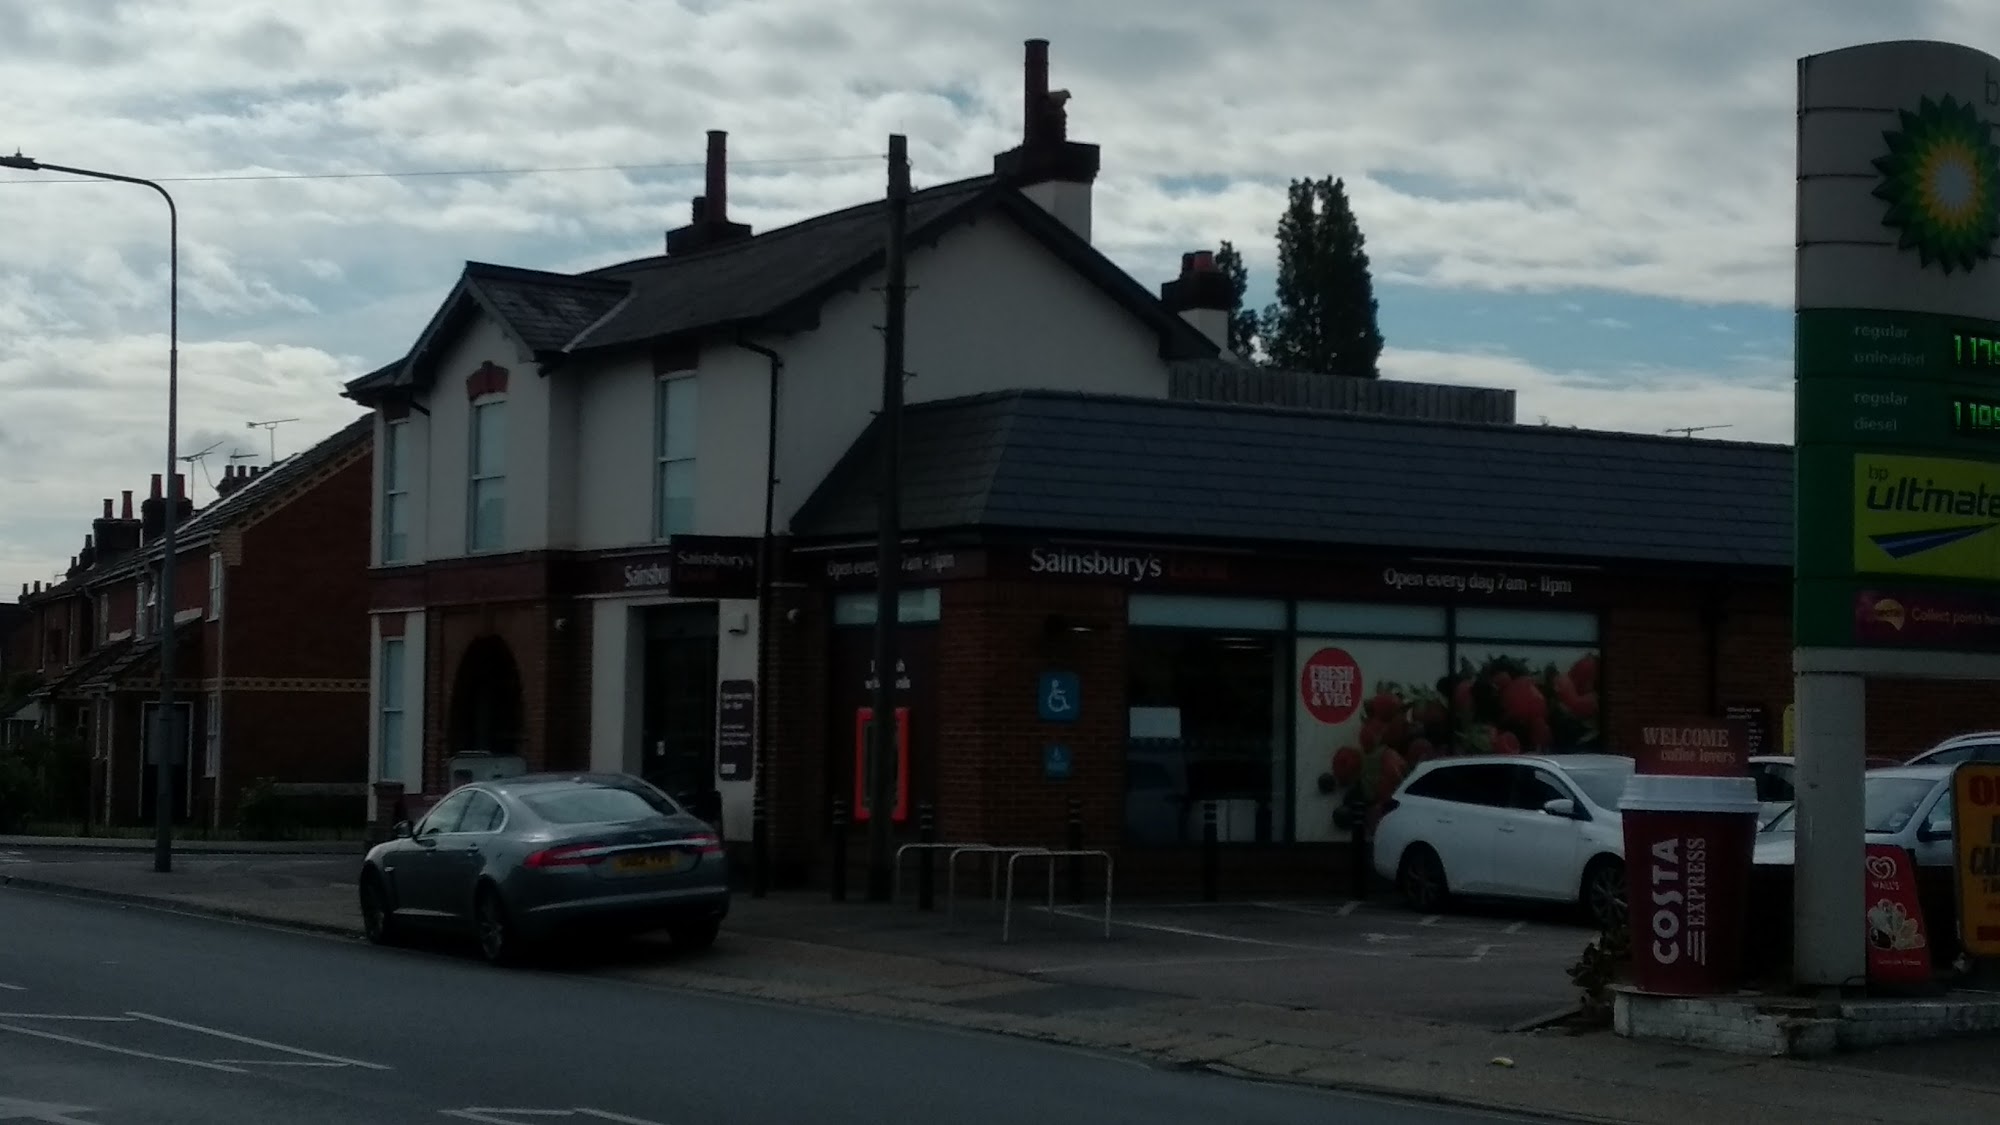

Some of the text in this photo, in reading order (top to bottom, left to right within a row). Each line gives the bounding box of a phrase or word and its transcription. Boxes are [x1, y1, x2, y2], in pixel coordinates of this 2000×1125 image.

[1854, 324, 1911, 340] regular
[1854, 350, 1926, 367] unleaded
[1853, 391, 1910, 409] regular
[1854, 416, 1898, 432] diesel
[1869, 464, 1889, 481] bp
[676, 550, 754, 571] Sainsbury's
[1029, 546, 1163, 582] Sainsbury's
[1383, 568, 1424, 588] Open
[1425, 573, 1466, 592] every
[1469, 573, 1494, 593] day
[1498, 573, 1528, 592] 7am
[1309, 665, 1354, 680] FRESH
[1311, 680, 1354, 694] FRUIT
[1323, 694, 1352, 707] VEG
[1640, 726, 1730, 748] WELCOME
[1686, 836, 1707, 928] EXPRESS
[1652, 837, 1684, 965] COSTA
